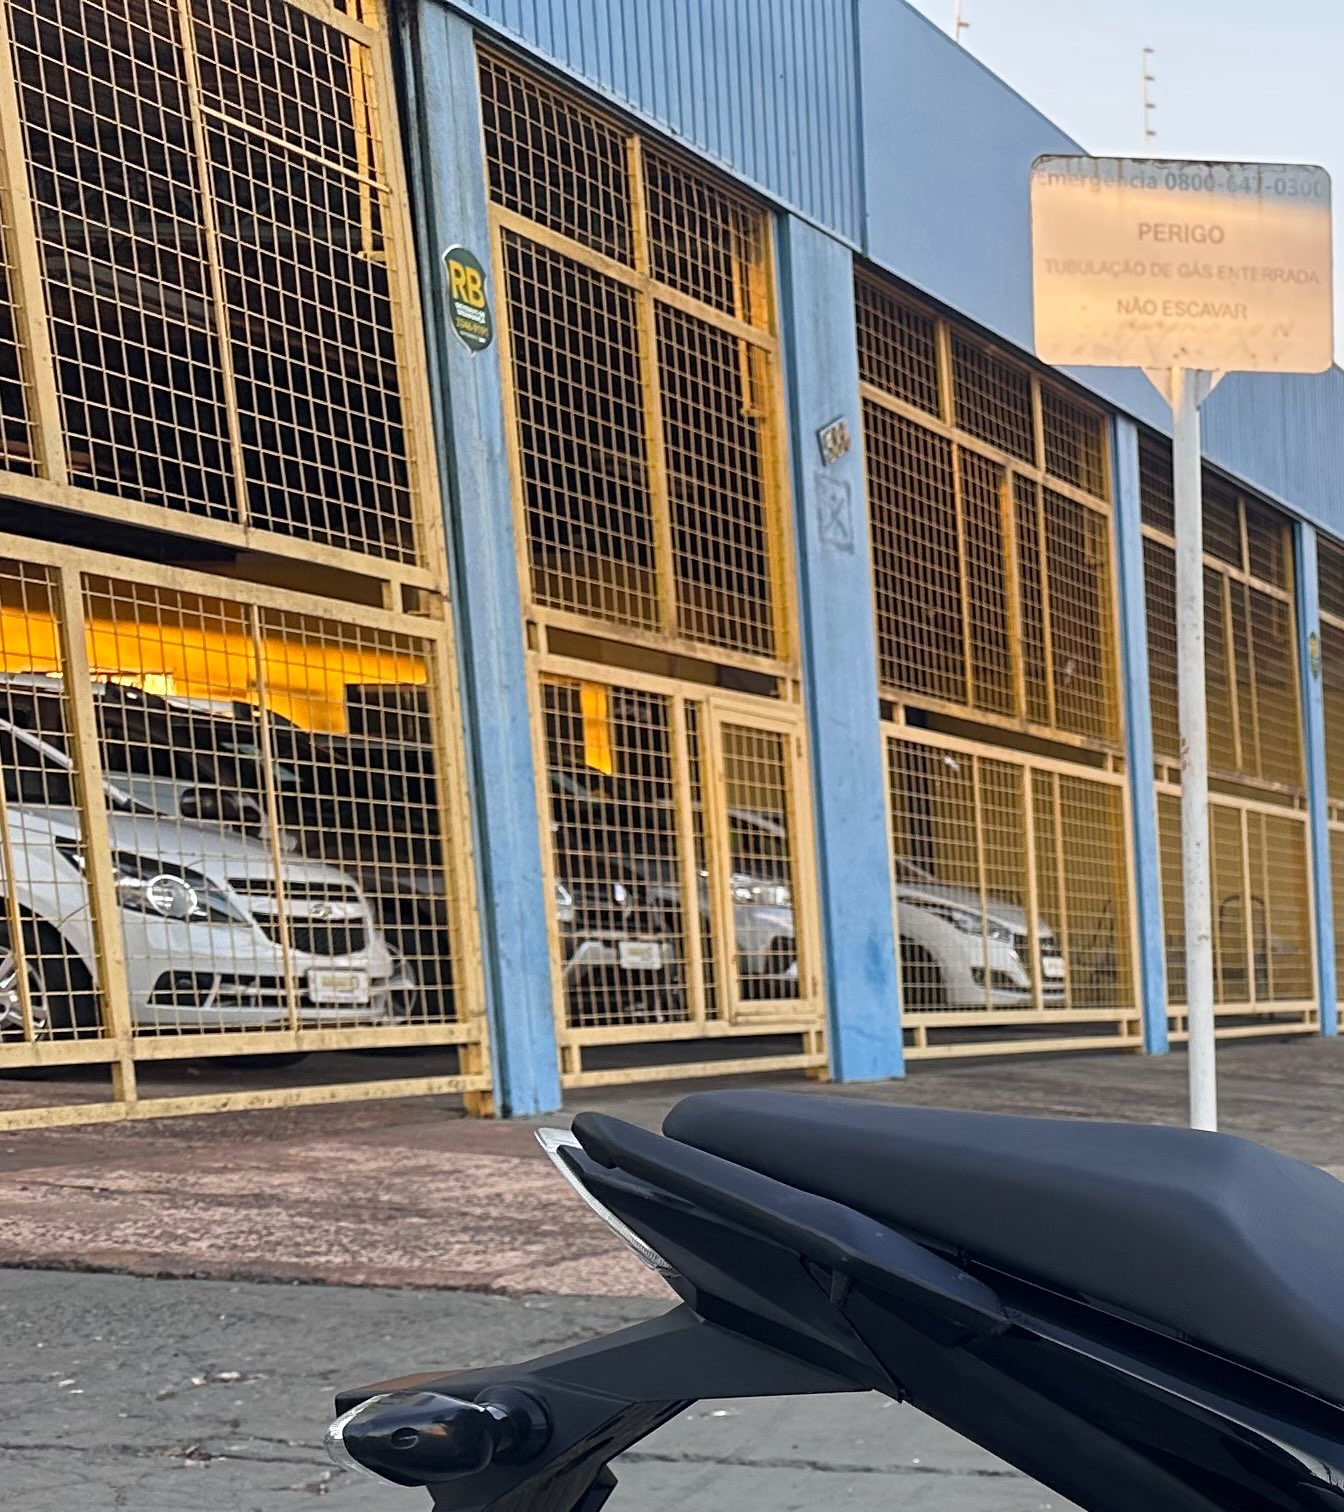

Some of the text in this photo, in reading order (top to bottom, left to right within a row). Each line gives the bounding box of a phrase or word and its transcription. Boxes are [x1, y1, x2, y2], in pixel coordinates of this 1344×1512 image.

[1138, 222, 1225, 245] PERIGO
[1045, 257, 1320, 285] TUBULAÇÃO DE GÁS ENTERRADA
[448, 259, 486, 309] RB
[1117, 296, 1248, 319] NÃO ESCAVAR
